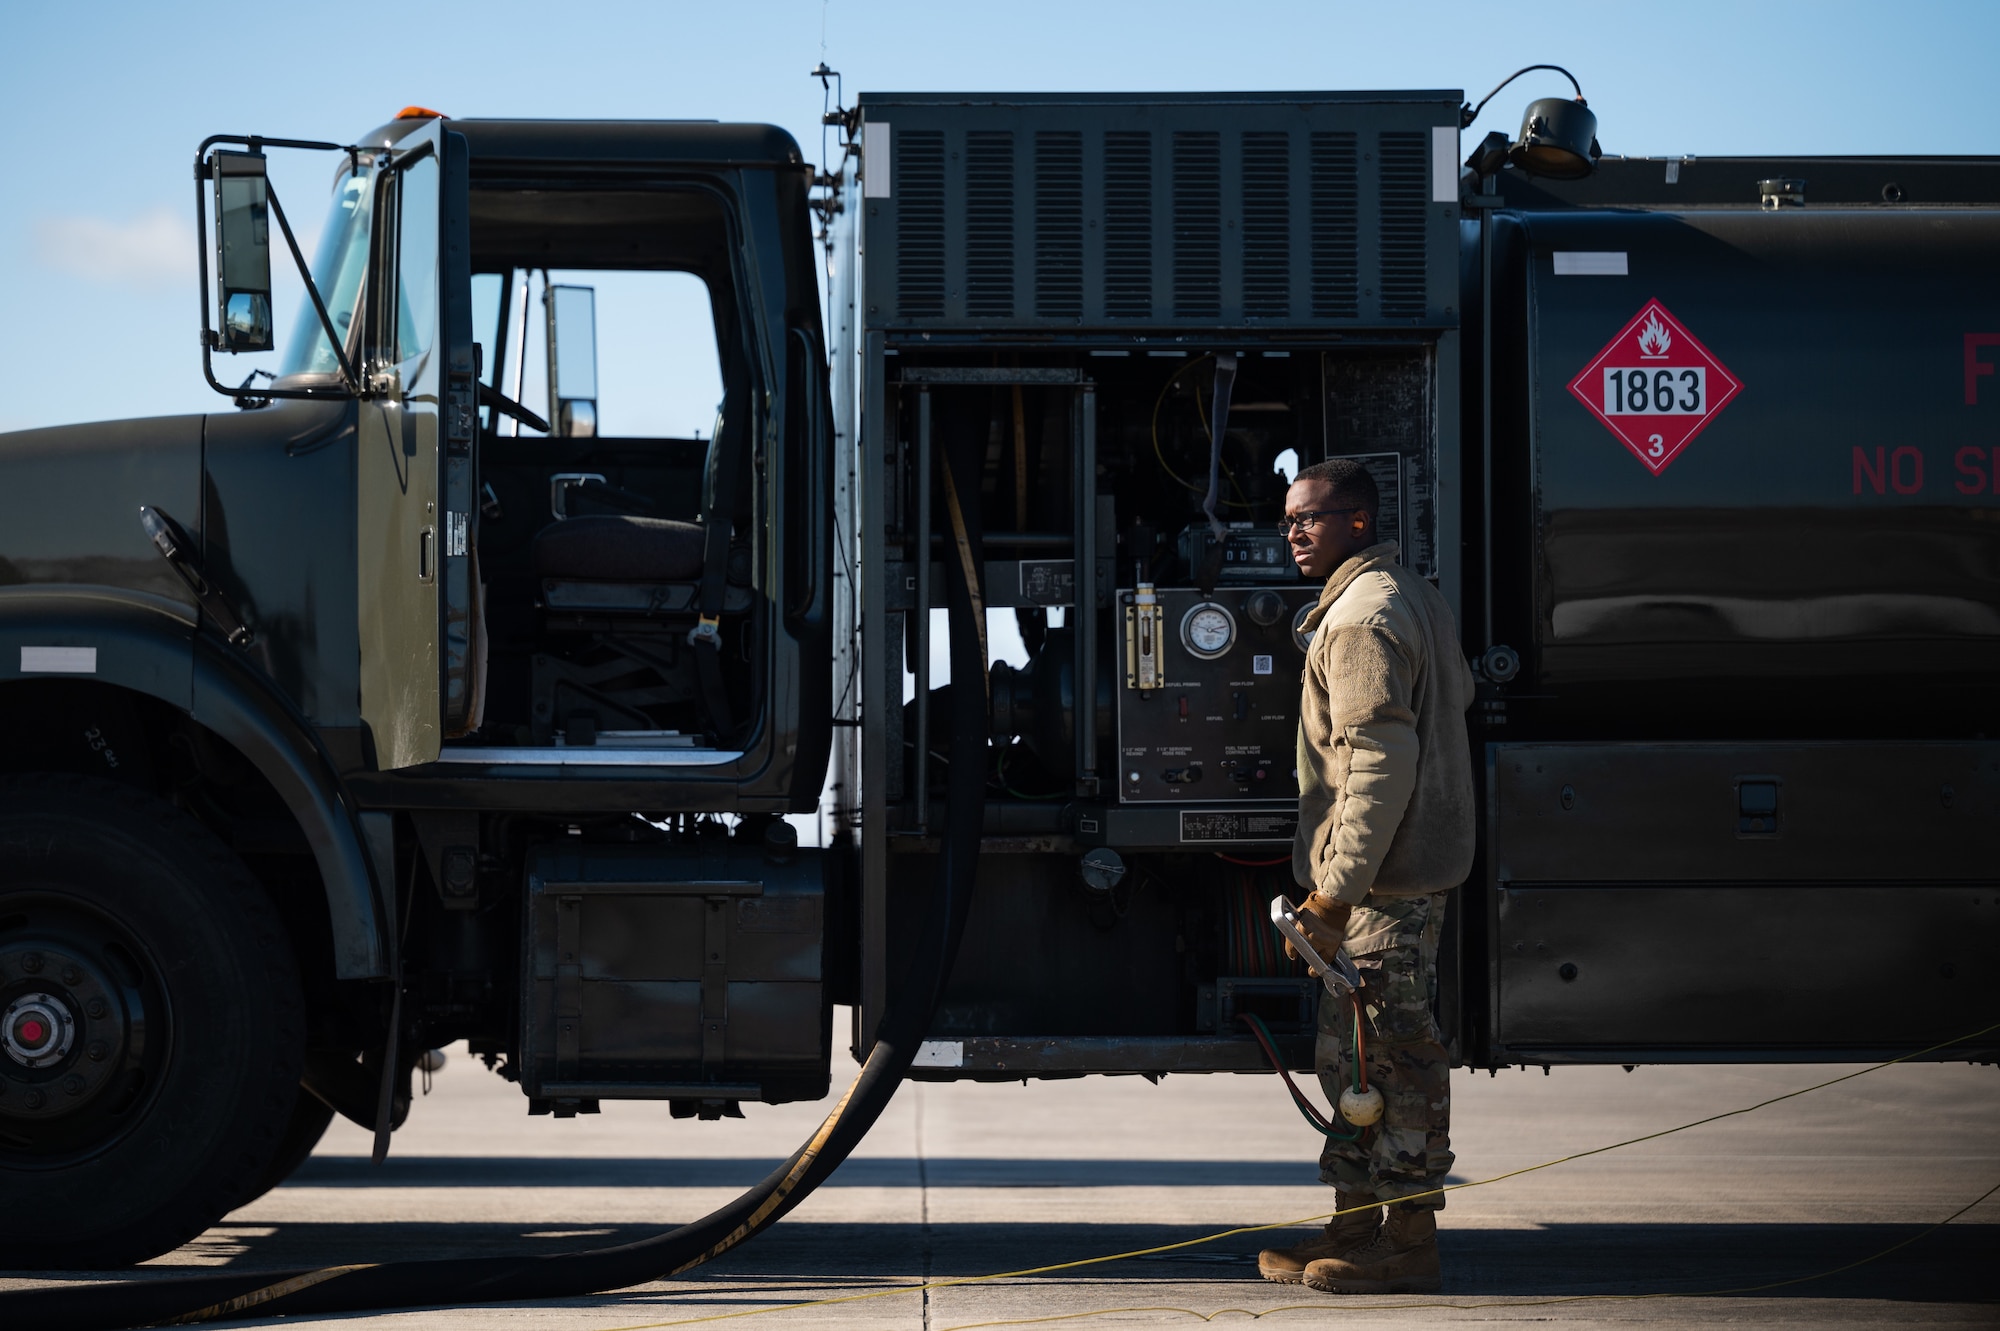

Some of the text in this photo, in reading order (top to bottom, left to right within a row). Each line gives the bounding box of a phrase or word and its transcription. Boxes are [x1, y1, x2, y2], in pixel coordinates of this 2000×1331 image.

[1609, 370, 1700, 412] 1863
[1648, 434, 1665, 458] 3
[1852, 445, 1925, 496] NO
